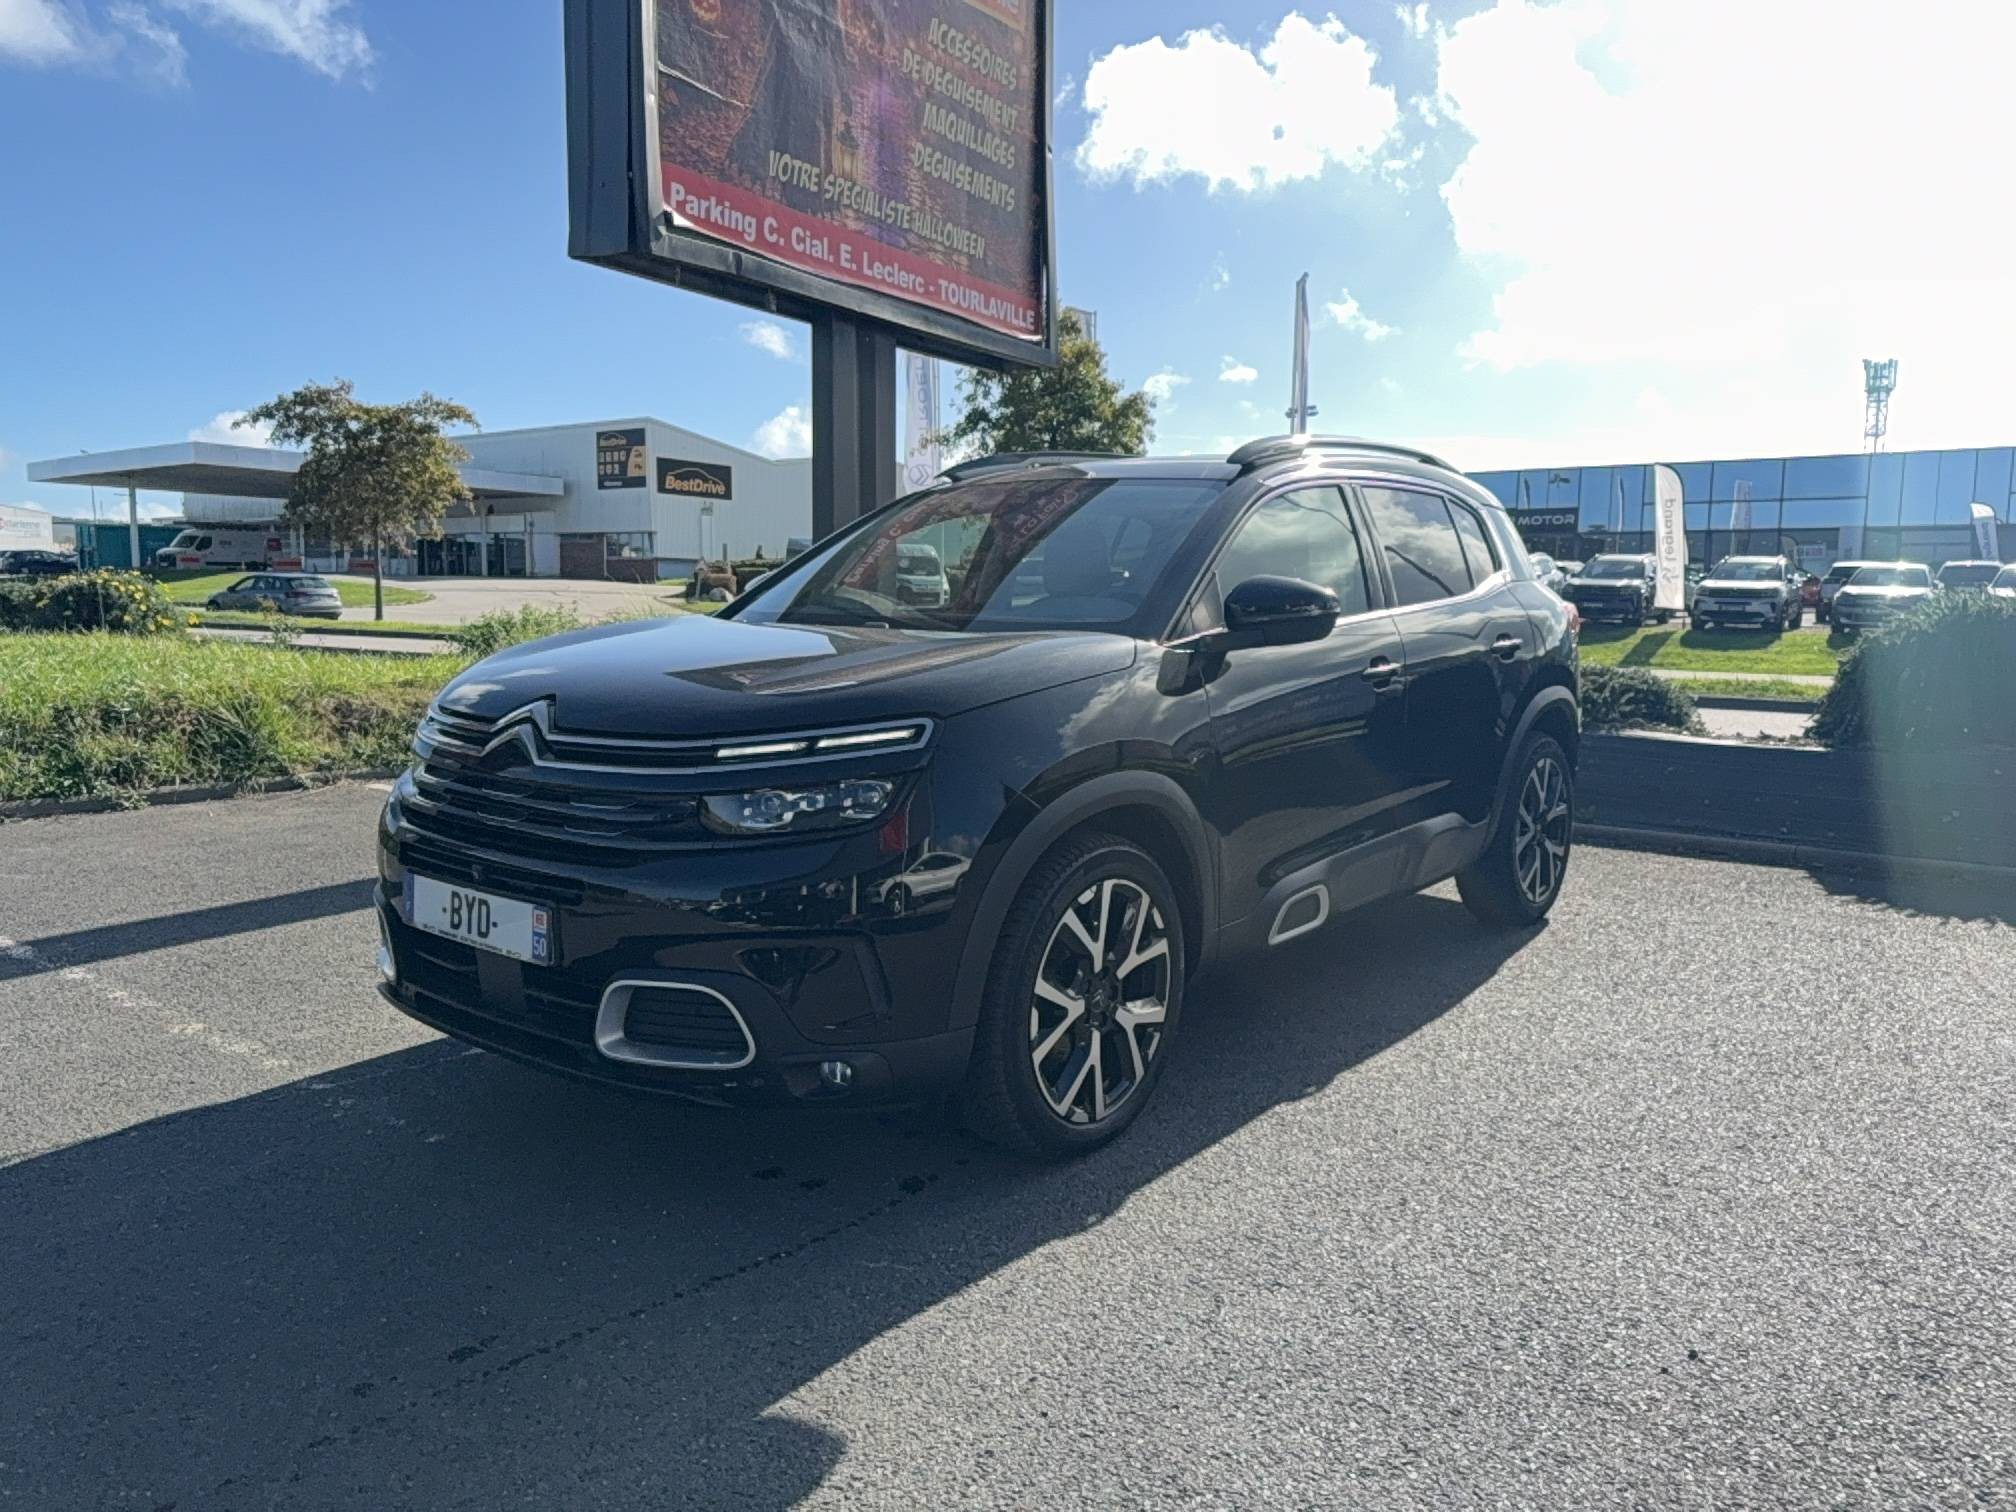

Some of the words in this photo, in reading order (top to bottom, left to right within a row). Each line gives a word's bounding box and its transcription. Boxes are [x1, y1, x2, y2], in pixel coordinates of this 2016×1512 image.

[902, 47, 921, 80] DE
[924, 61, 1018, 130] DEGUISEMENT
[928, 17, 1017, 91] ACCESSOIRES
[923, 102, 1016, 170] MAQUILLAGES
[769, 150, 820, 193] VOTRE
[824, 174, 911, 230] SPECIALISTE
[914, 212, 985, 260] HALLOWEEN
[914, 141, 1016, 212] DEGUISEMENTS
[670, 181, 757, 243] Parking
[763, 216, 785, 247] C.
[791, 226, 834, 264] Cial.
[839, 243, 857, 271] E.
[863, 251, 925, 294] Leclerc
[938, 278, 1035, 331] TOURLAVILLE
[665, 475, 726, 495] BestDrive
[450, 890, 491, 938] BYD
[533, 935, 546, 957] 50
